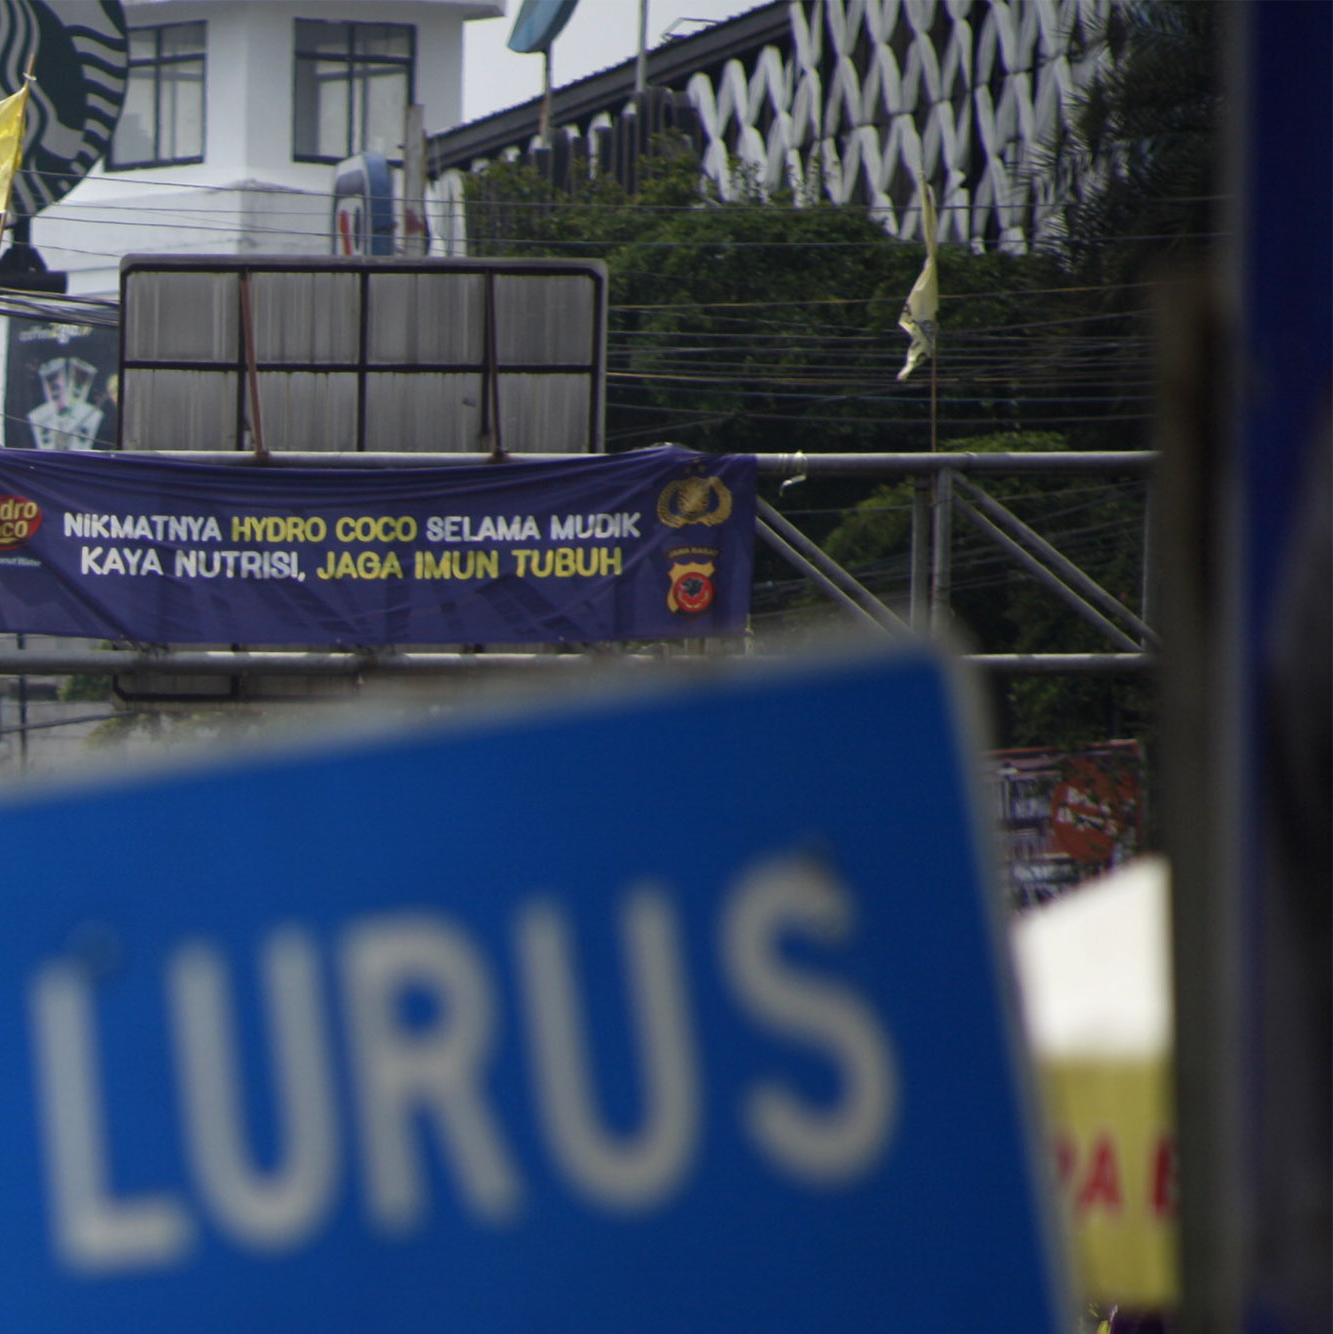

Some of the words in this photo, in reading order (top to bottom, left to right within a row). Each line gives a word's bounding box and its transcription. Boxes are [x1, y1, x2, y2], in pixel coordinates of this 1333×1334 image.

[64, 513, 221, 541] NIKMATNYA
[232, 517, 327, 542] HYDRO
[336, 516, 417, 541] COCO
[426, 515, 541, 541] SELAMA
[551, 513, 641, 540] MUDIK
[81, 546, 164, 576] KAYA
[175, 551, 306, 581] NUTRISI,
[317, 551, 404, 579] JAGA
[414, 551, 499, 579] IMUN
[512, 547, 622, 577] TUBUH
[30, 850, 900, 1277] LURUS
